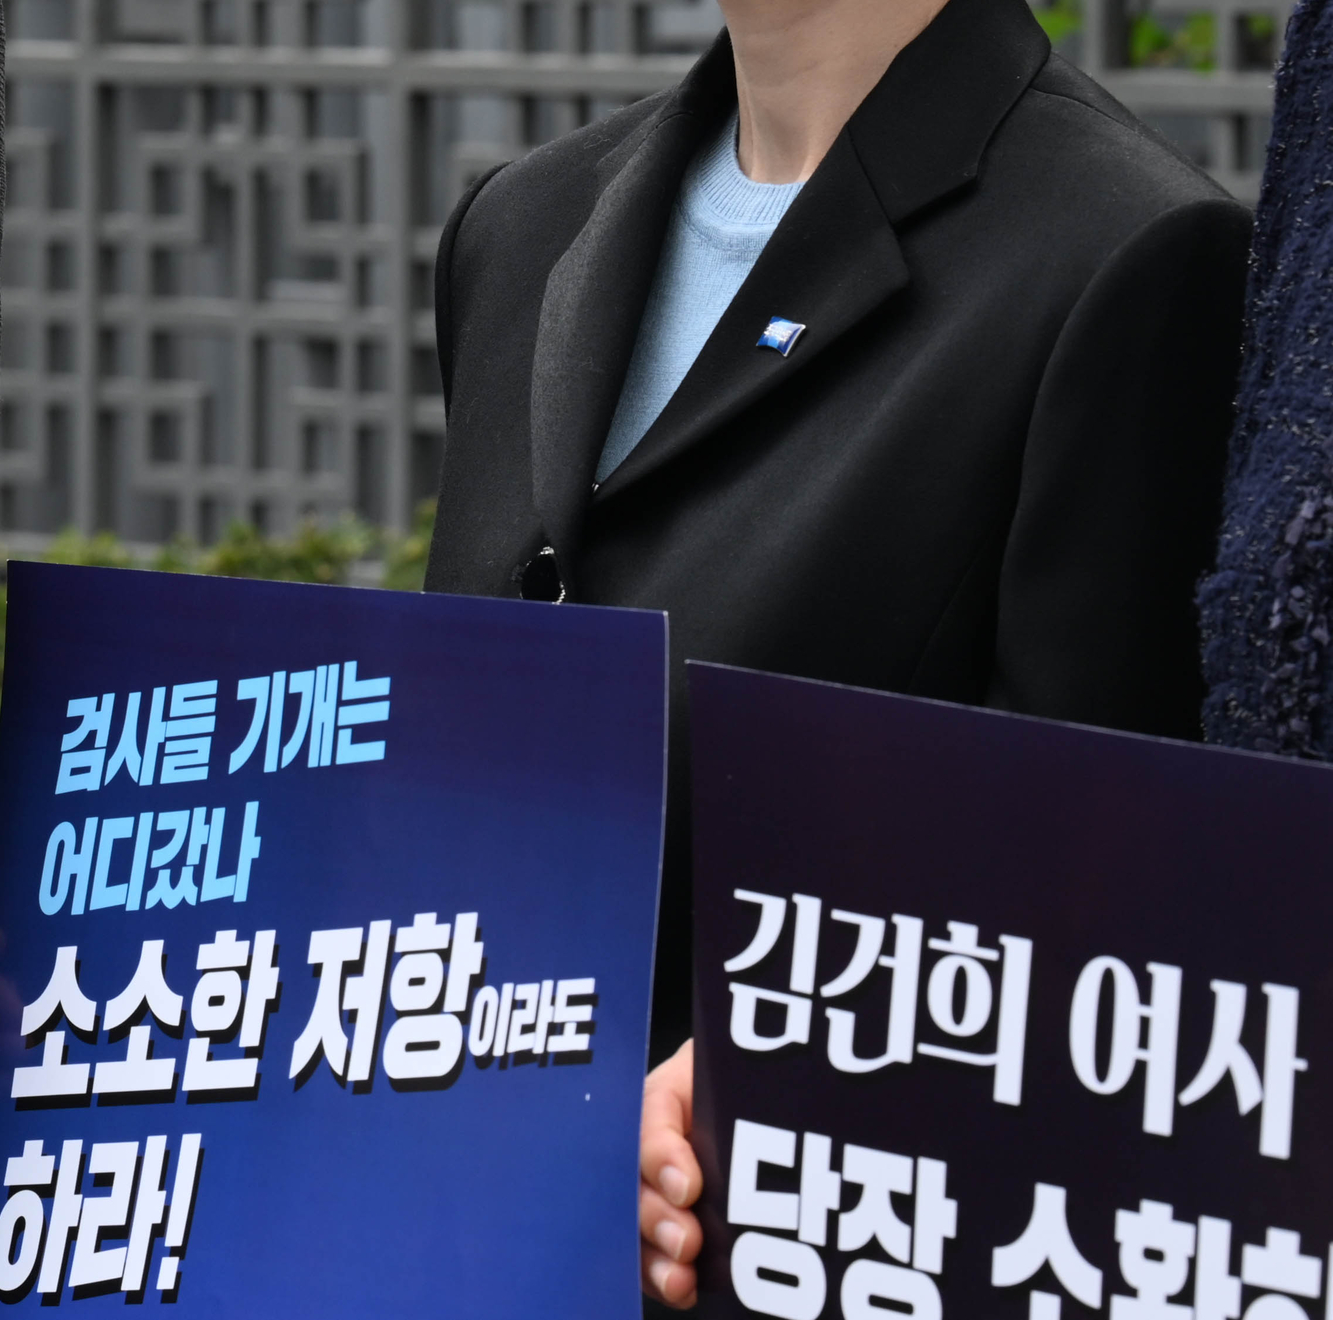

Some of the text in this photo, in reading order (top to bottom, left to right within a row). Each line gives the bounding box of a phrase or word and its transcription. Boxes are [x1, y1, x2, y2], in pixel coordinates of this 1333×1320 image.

[55, 661, 391, 795] 검사들 기개는
[38, 800, 261, 916] 어디갔나
[10, 911, 596, 1099] 소소한 저항이라도
[724, 888, 1309, 1160] 김건희 여사
[727, 1118, 958, 1320] 당장
